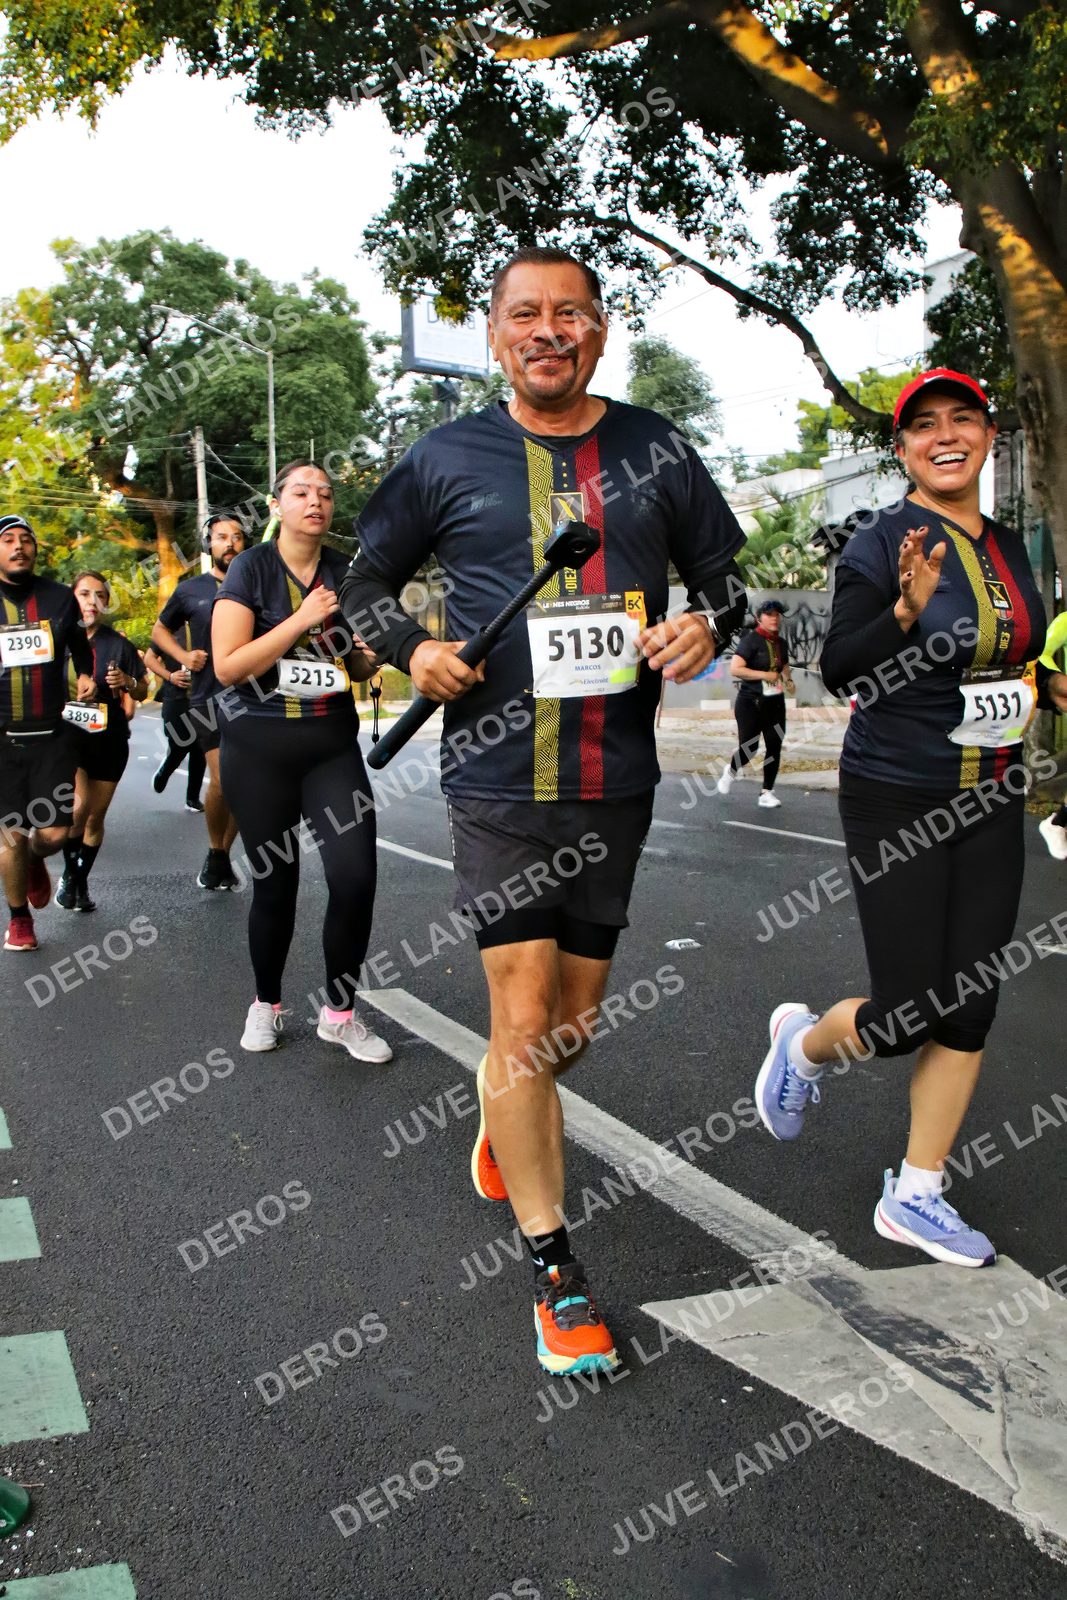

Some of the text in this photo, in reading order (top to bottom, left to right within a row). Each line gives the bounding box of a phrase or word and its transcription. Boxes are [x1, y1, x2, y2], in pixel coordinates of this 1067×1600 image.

[7, 635, 42, 651] 2390
[548, 625, 624, 661] 5130
[290, 666, 335, 687] 5215
[67, 710, 98, 723] 3894
[974, 691, 1021, 721] 5131
